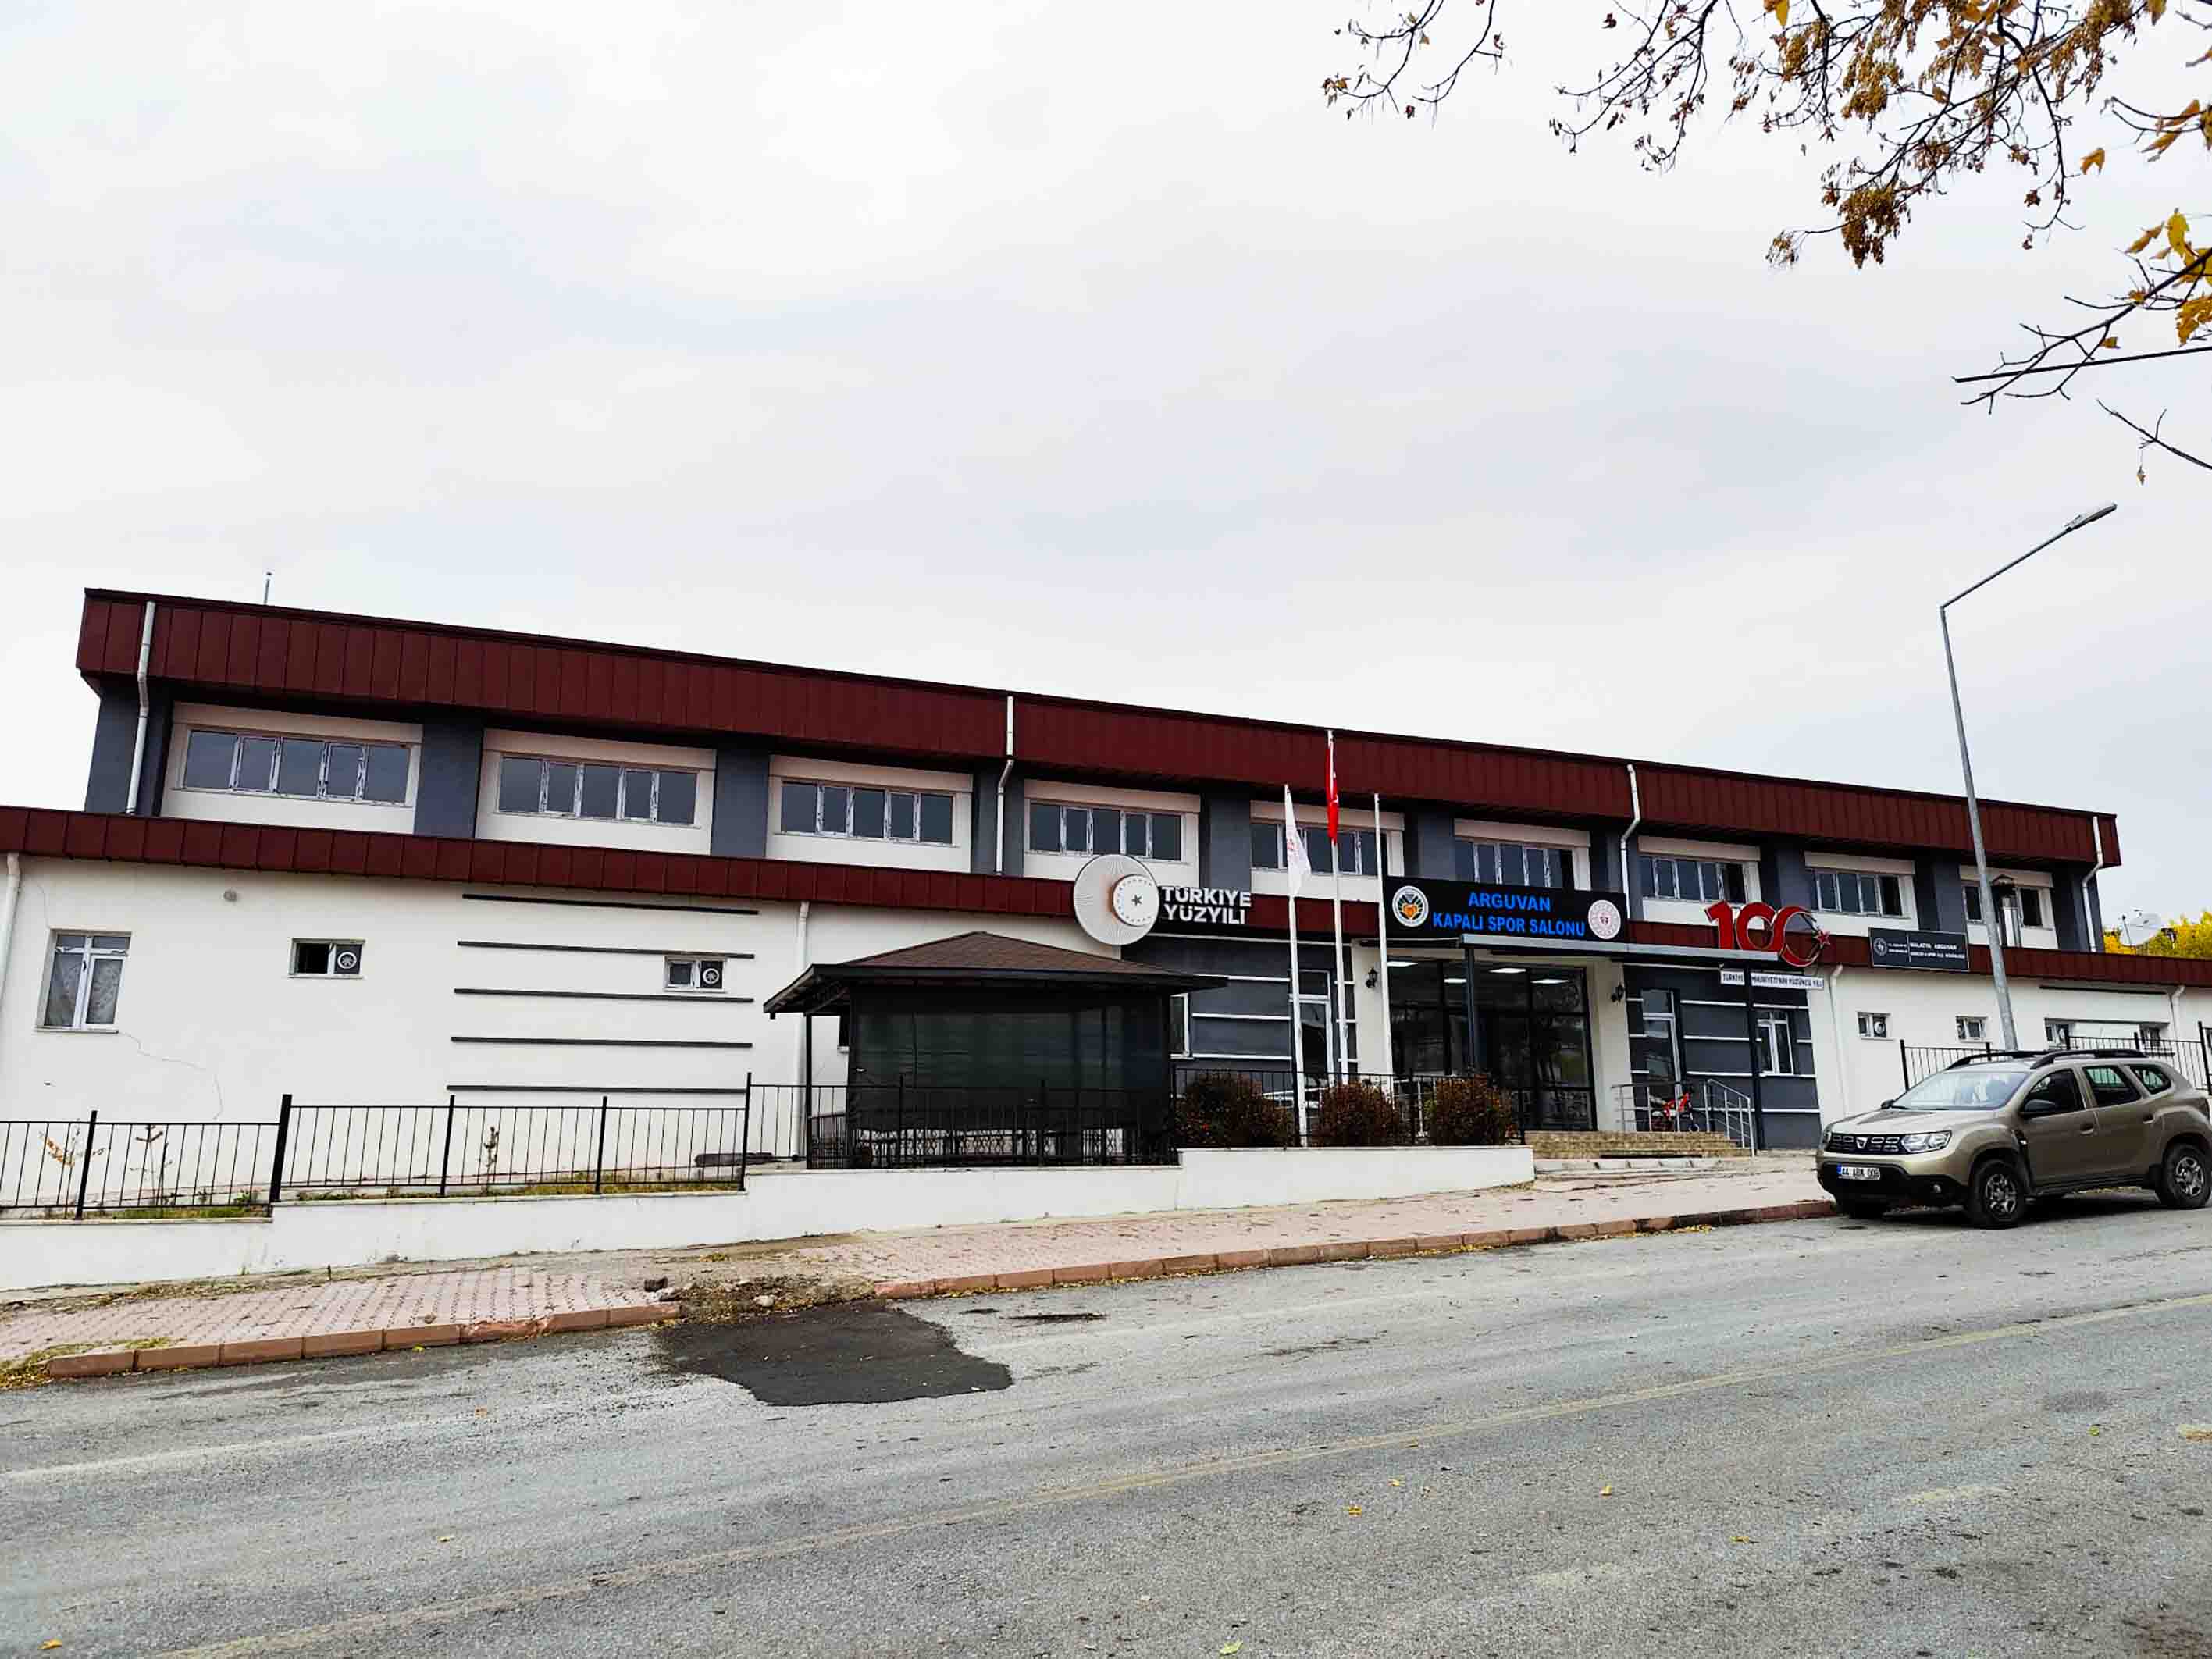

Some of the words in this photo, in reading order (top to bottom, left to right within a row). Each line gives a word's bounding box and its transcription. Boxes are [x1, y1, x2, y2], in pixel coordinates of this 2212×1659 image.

[1467, 892, 1551, 912] ARGUVAN
[1163, 903, 1246, 925] YÜZYILI
[1432, 912, 1484, 931] KAPALI
[1487, 916, 1526, 934] SPOR
[1529, 918, 1586, 937] SALONU
